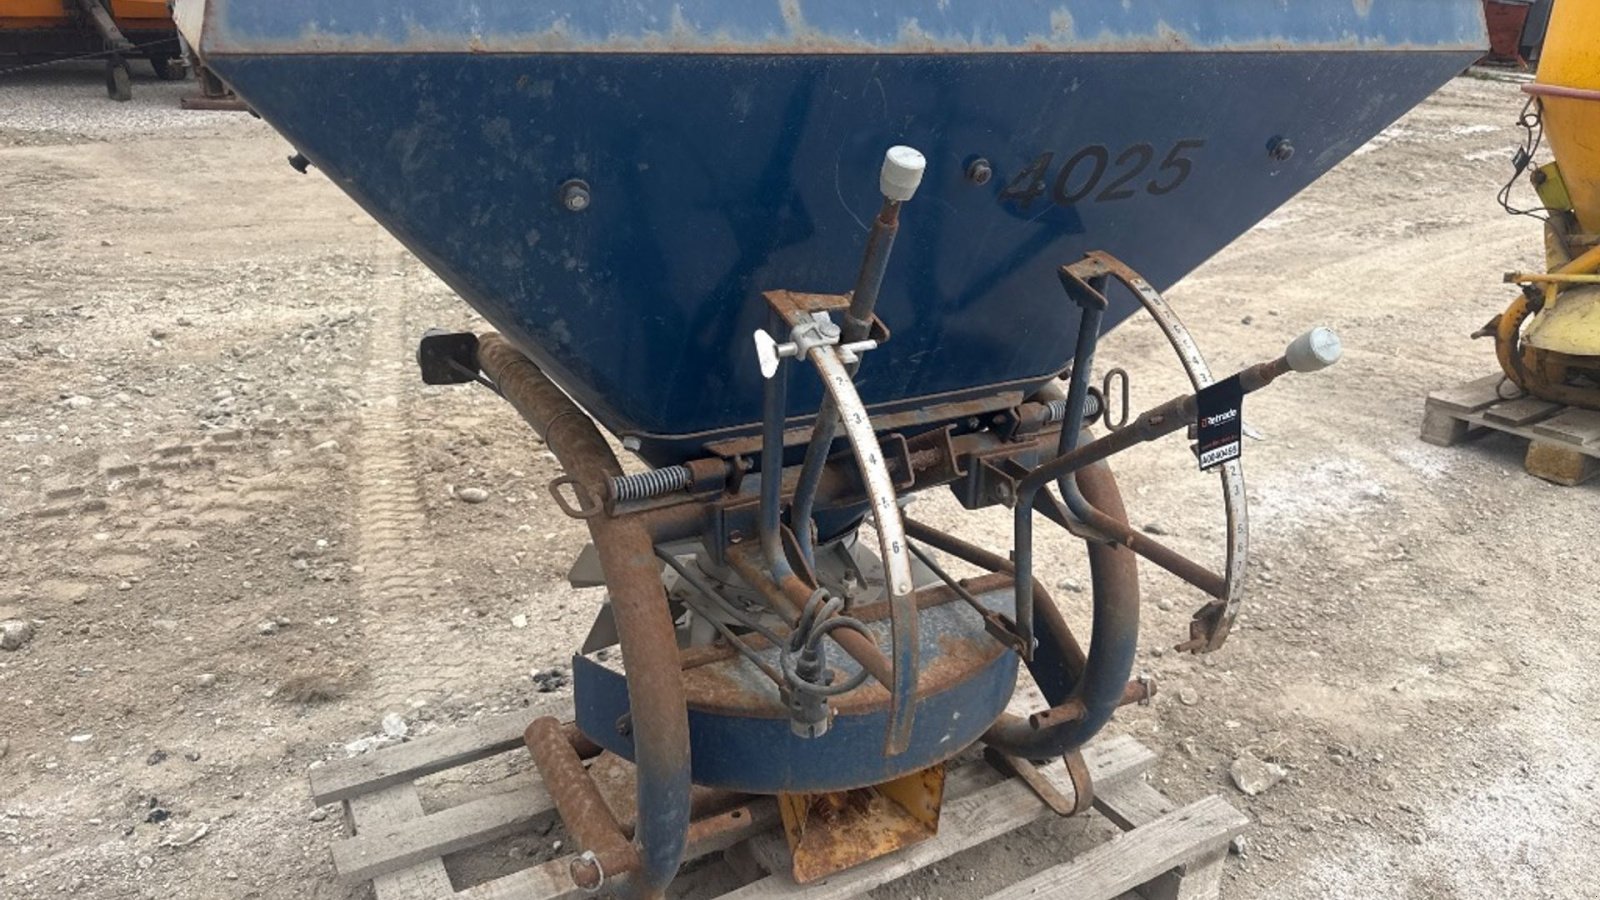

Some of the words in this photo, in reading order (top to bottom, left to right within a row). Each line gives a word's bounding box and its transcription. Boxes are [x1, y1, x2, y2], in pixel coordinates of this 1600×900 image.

[998, 140, 1205, 207] 4025
[1207, 407, 1238, 425] Retrade
[853, 412, 863, 425] 3
[868, 453, 878, 466] 4
[892, 541, 900, 554] 6
